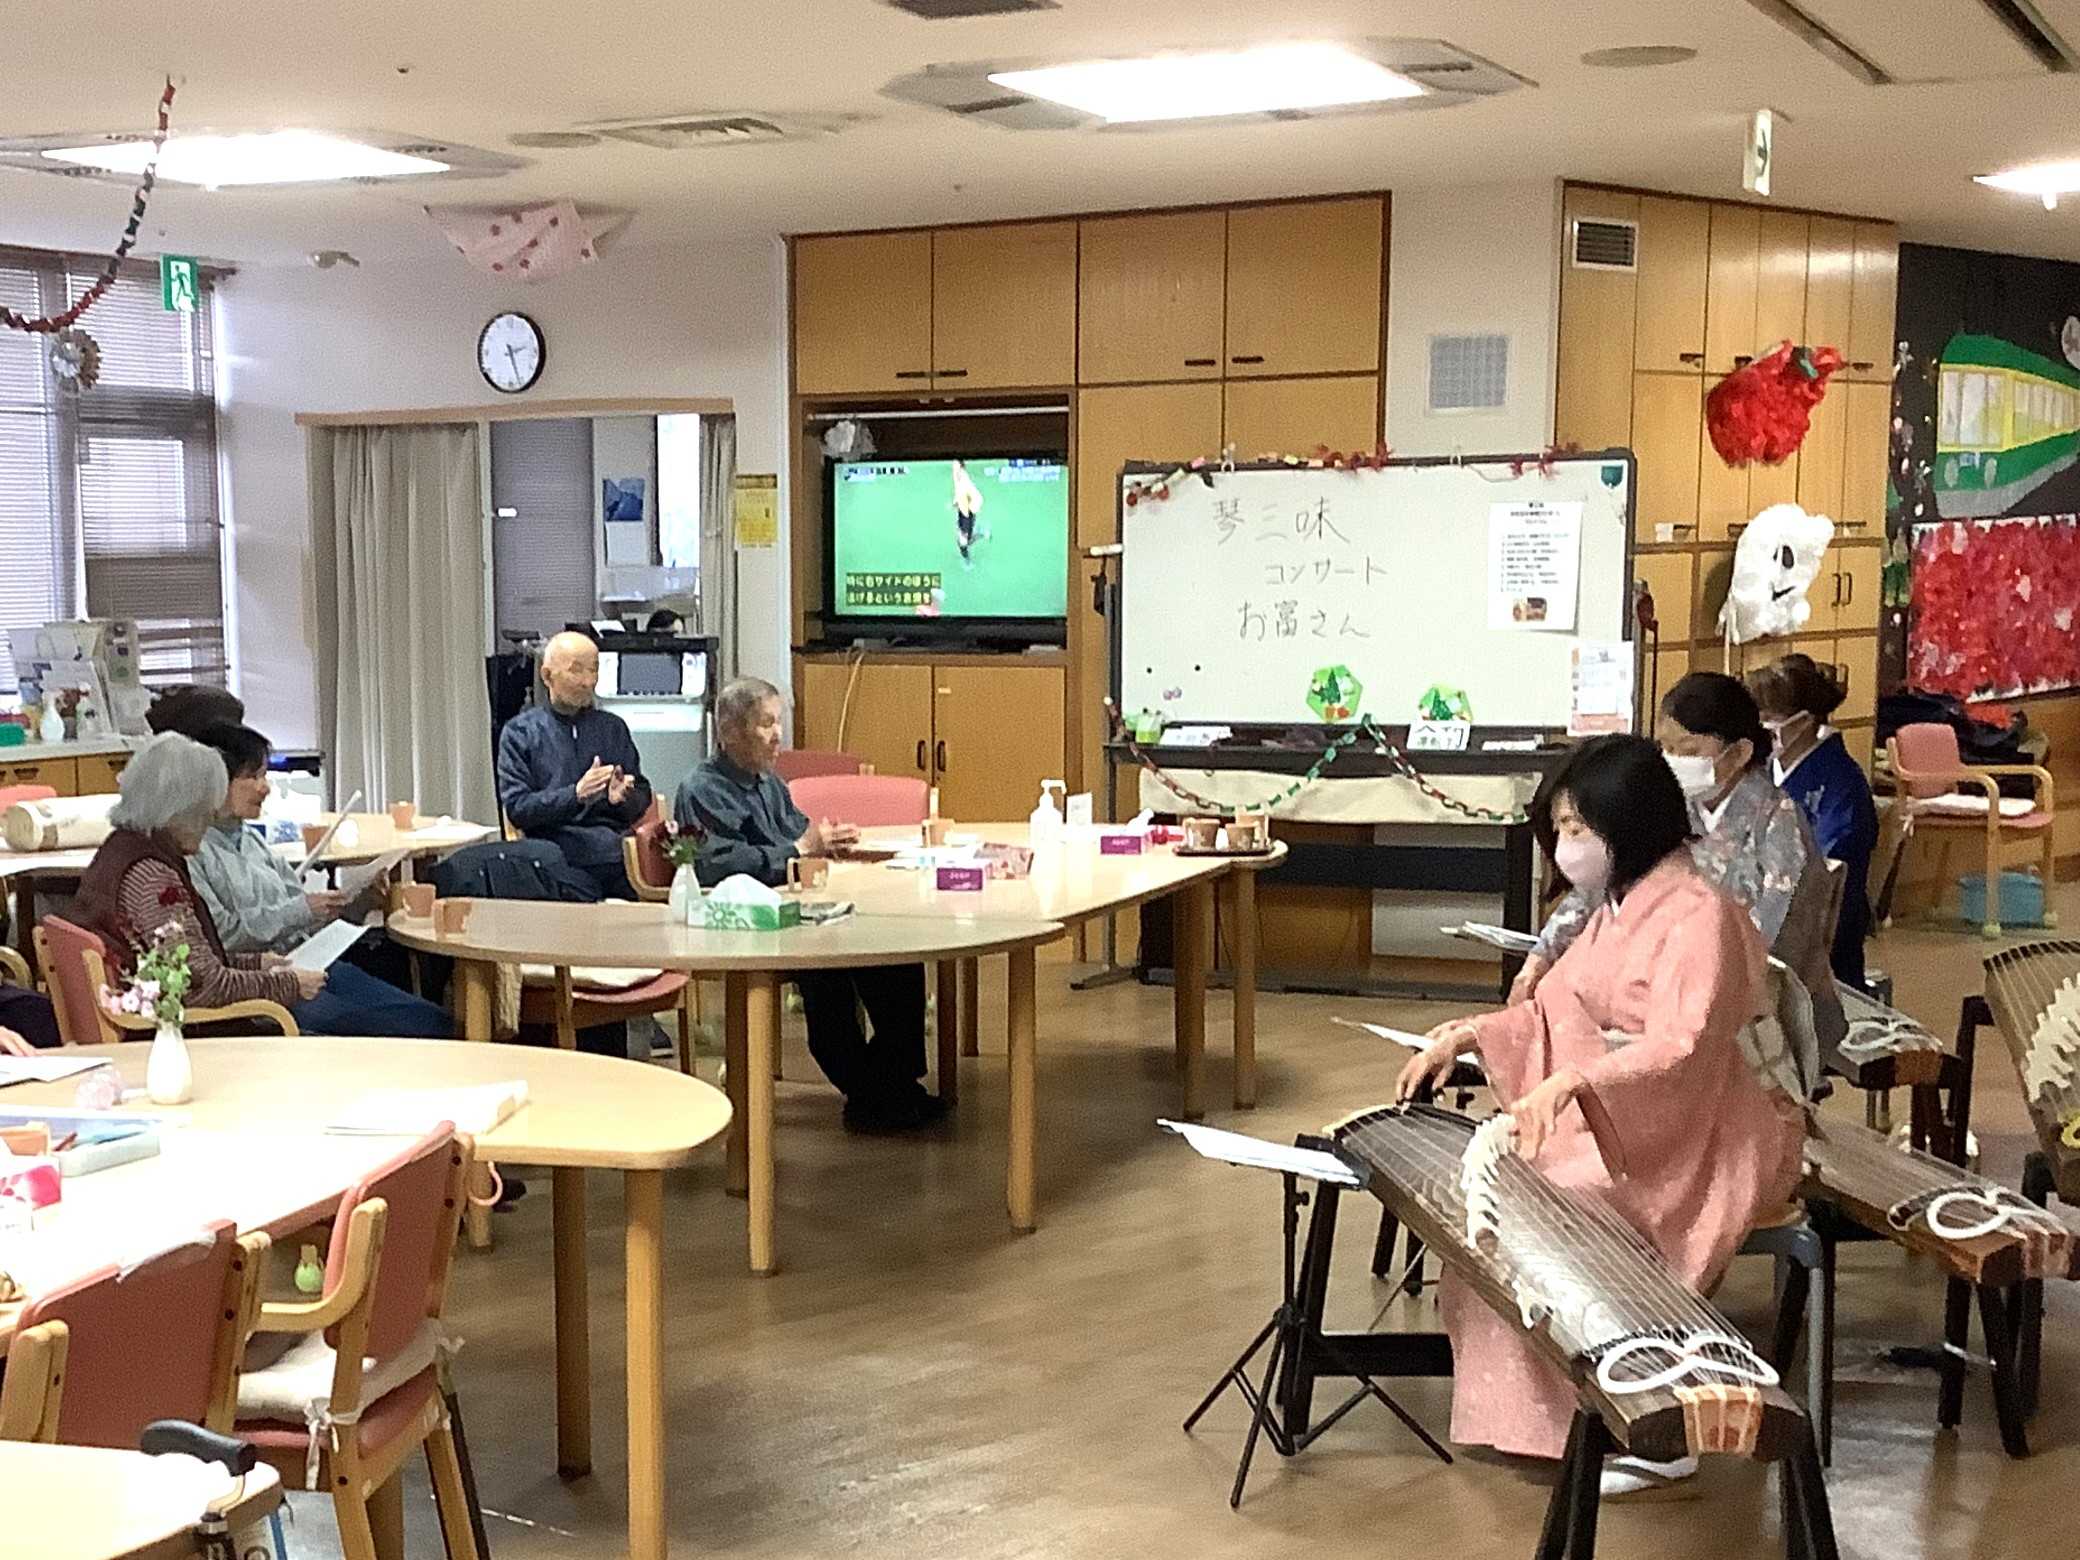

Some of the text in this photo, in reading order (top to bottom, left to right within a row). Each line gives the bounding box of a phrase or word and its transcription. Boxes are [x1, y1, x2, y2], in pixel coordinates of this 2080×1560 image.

[1212, 496, 1351, 546] 琴三味
[1265, 555, 1388, 585] コンサート
[1237, 600, 1372, 642] お富さん
